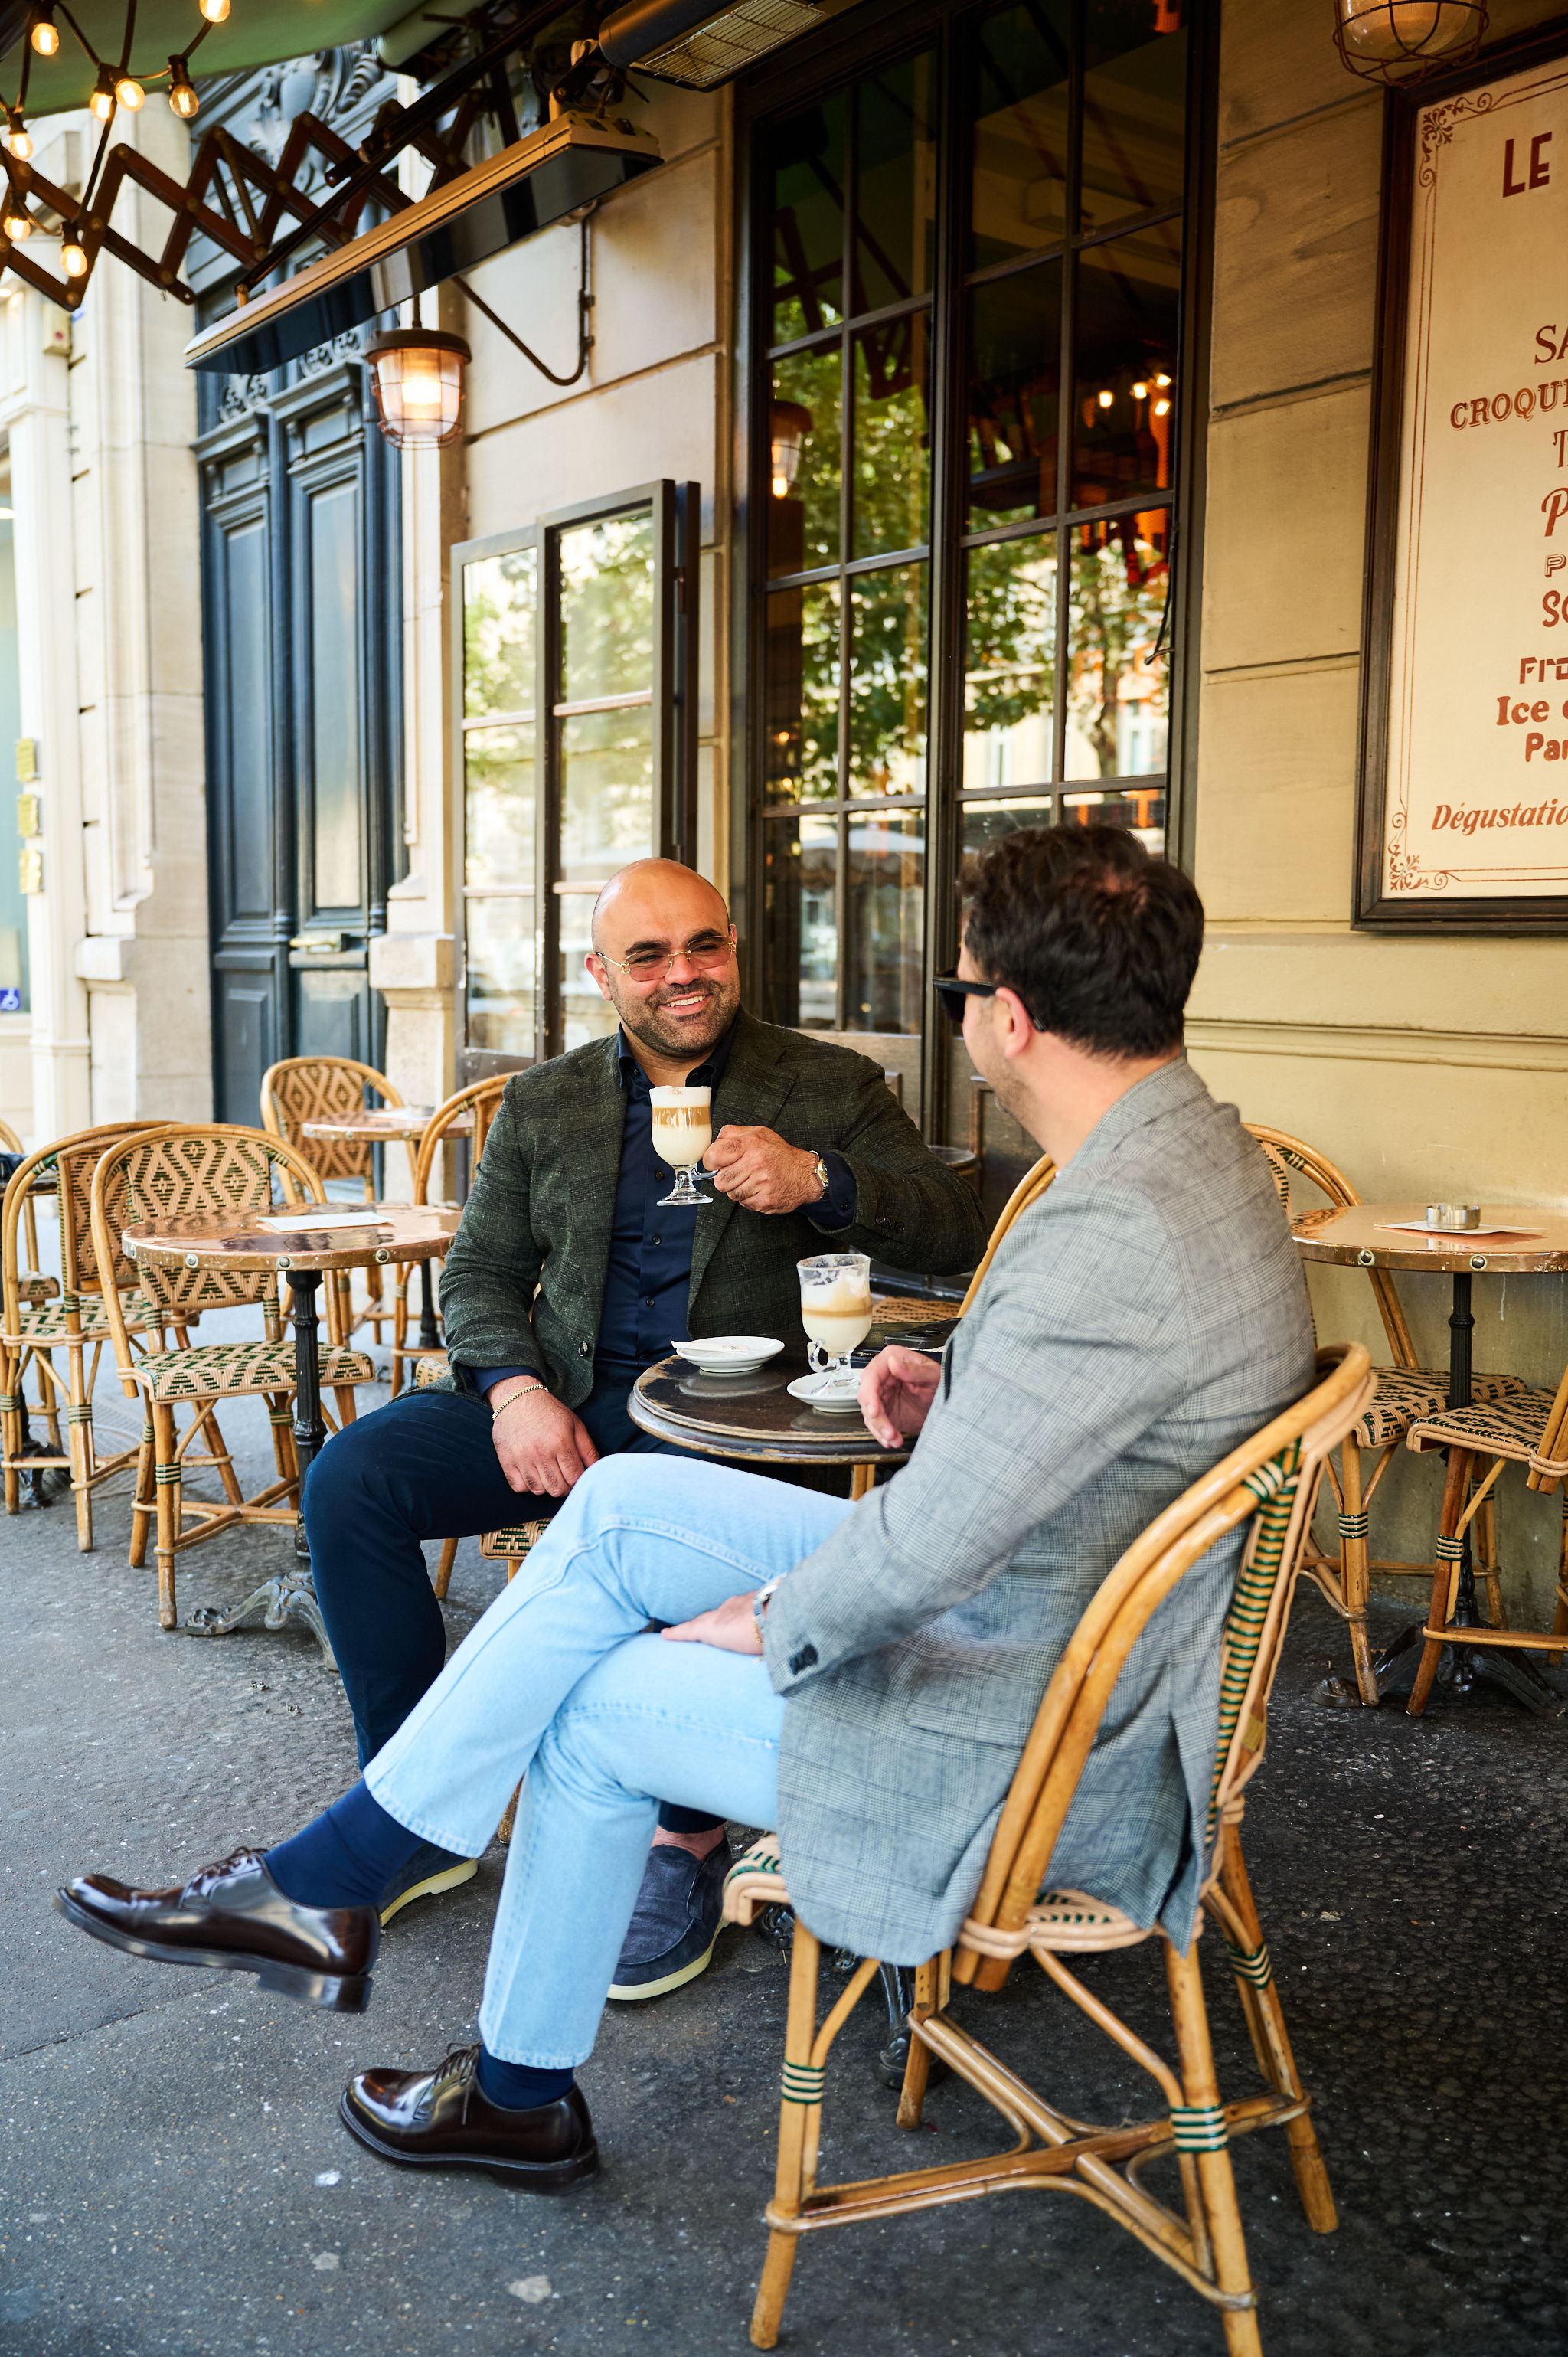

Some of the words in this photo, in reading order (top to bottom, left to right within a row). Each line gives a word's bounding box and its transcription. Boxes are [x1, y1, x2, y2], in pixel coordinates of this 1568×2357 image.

[1502, 131, 1552, 198] LE
[1450, 379, 1568, 430] CROQU
[1541, 488, 1568, 537] P
[1544, 554, 1567, 578] P
[1496, 695, 1550, 726] Ice
[1432, 799, 1568, 836] Dégustatio
